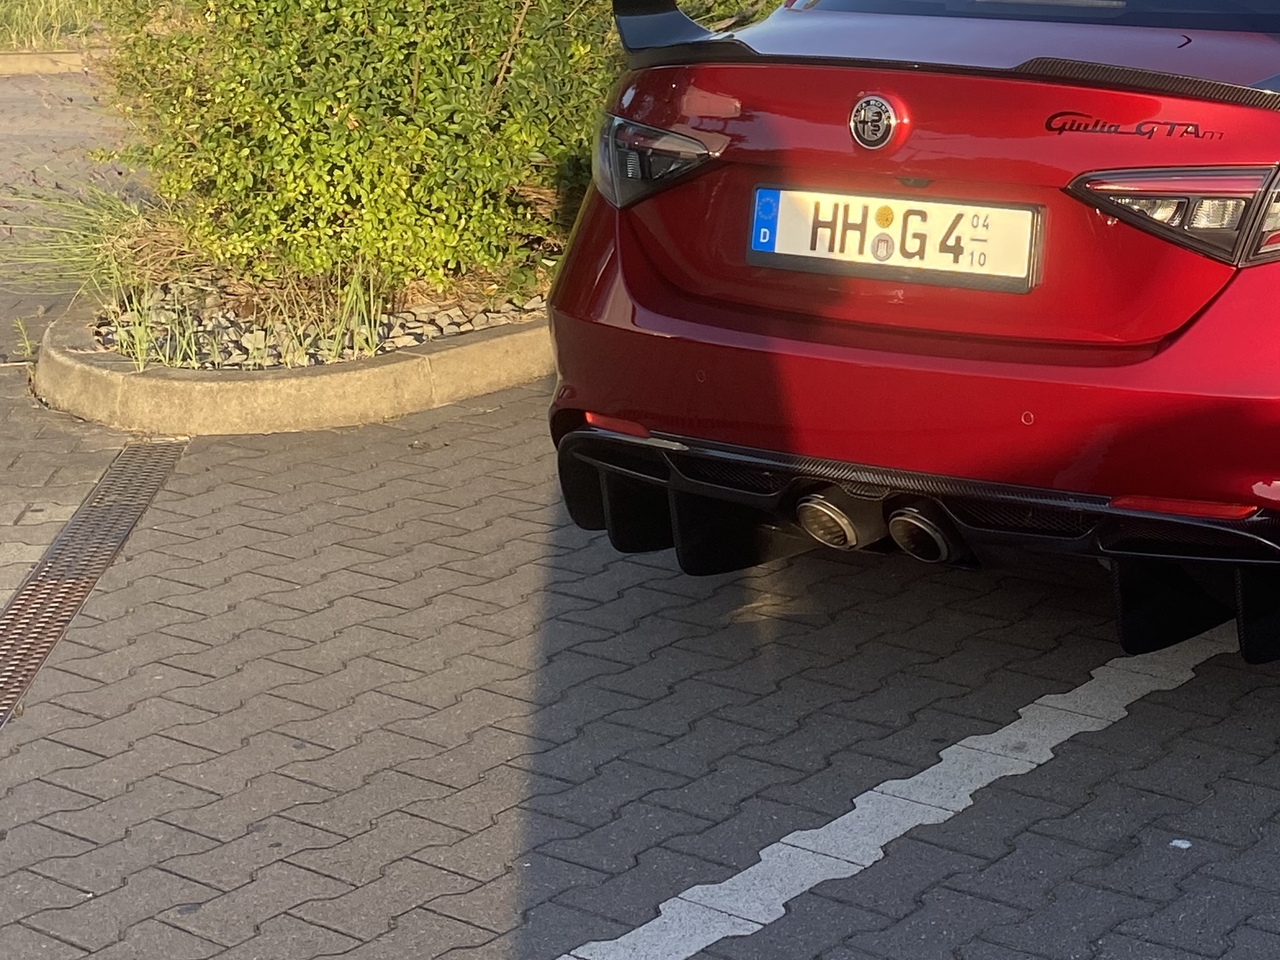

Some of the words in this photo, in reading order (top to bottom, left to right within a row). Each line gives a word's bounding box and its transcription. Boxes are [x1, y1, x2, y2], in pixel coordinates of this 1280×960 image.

[1045, 111, 1120, 135] Giulia
[810, 200, 869, 256] HH
[970, 213, 990, 230] 04
[759, 227, 770, 243] D
[969, 251, 987, 267] 10
